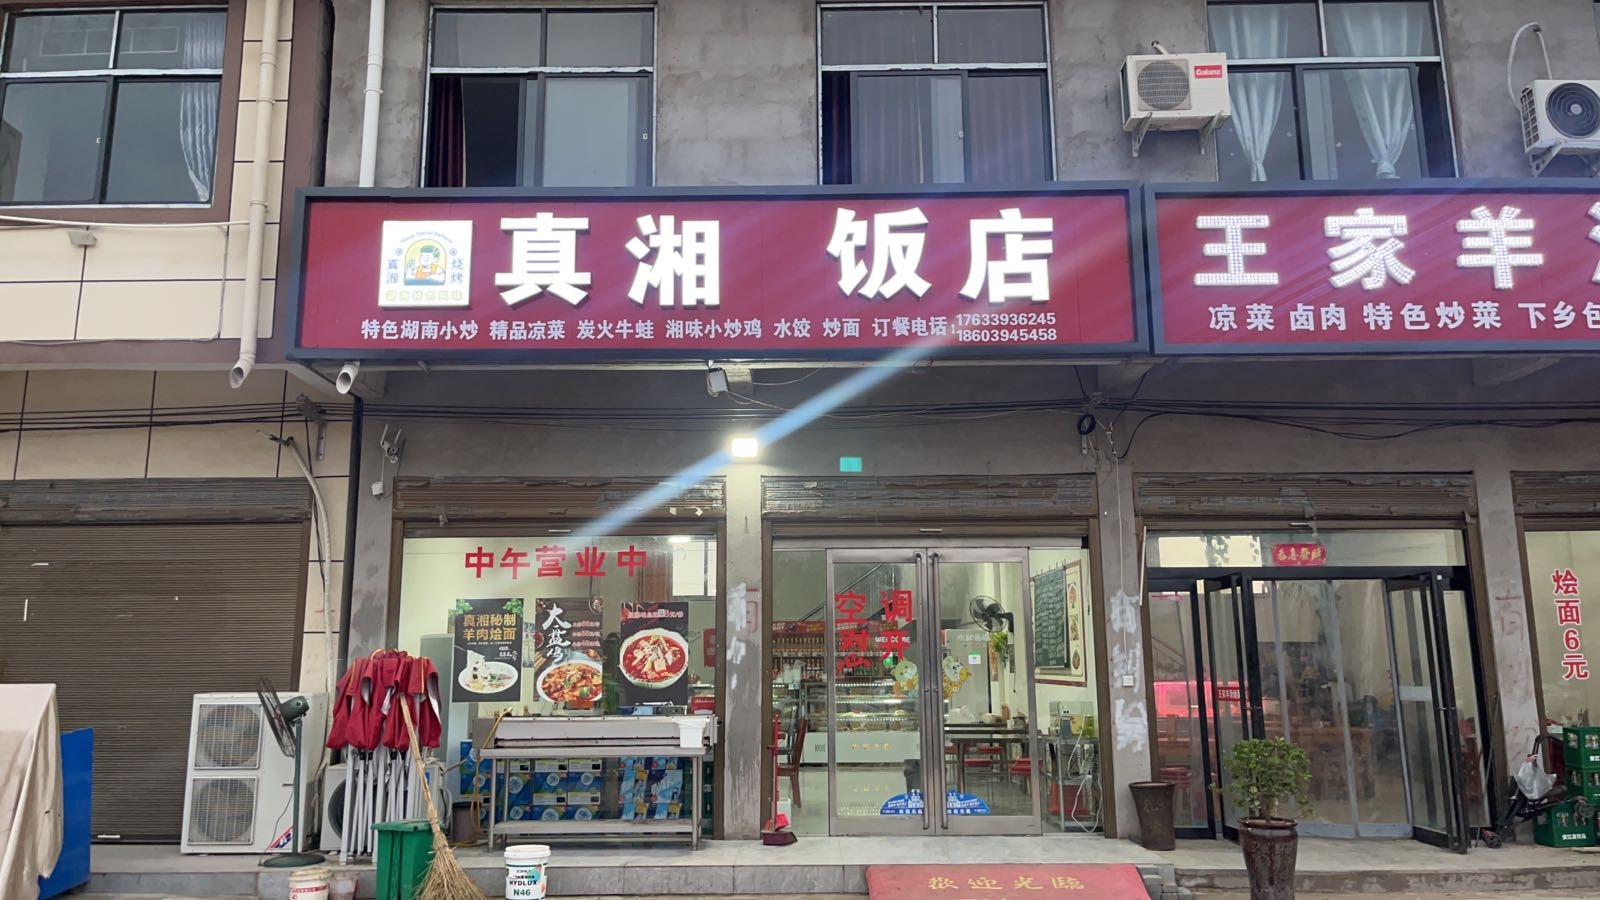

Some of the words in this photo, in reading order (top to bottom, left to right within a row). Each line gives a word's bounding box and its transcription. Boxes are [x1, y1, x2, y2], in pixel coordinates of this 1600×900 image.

[495, 212, 720, 306] 真湘
[826, 207, 1054, 303] 饭店
[1193, 201, 1600, 290] 王家羊
[361, 319, 478, 340] 特色湖南小炒
[489, 319, 565, 340] 精品凉菜
[577, 319, 654, 339] 炭火牛蛙
[666, 318, 762, 339] 湘味小炒鸡
[774, 318, 811, 338] 水饺
[823, 317, 860, 338] 炒面
[872, 316, 947, 337] 订餐电话
[955, 313, 1056, 326] 17633936245
[1209, 303, 1275, 331] 凉菜
[1290, 303, 1347, 331] 卤肉
[1362, 302, 1501, 331] 特色炒菜
[957, 328, 1057, 342] 18603945458
[465, 545, 647, 579] 中午营业中
[463, 613, 517, 627] 真湘秘制
[834, 590, 913, 624] 空调
[463, 627, 517, 641] 羊肉烩面
[1551, 568, 1589, 681] 烩面6元
